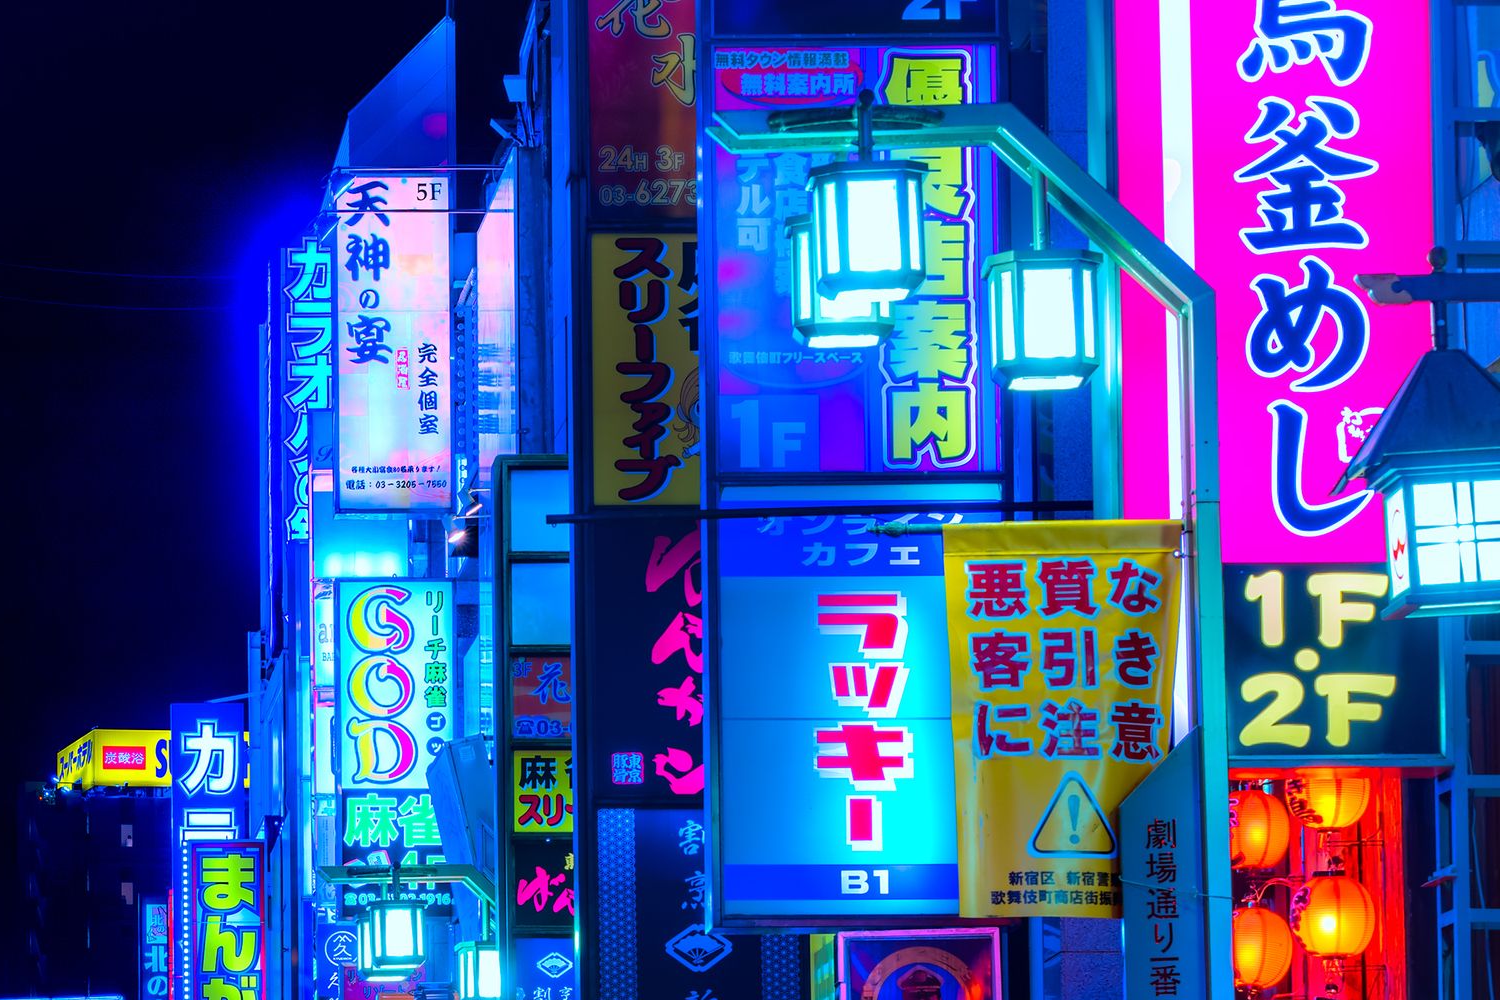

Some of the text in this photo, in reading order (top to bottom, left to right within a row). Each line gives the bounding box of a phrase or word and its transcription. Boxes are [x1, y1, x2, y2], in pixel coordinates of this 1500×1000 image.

[715, 51, 850, 69] 無料タウン情報満載
[740, 72, 857, 96] 無料案内所
[598, 146, 685, 172] 24H 3F
[416, 182, 443, 202] 5F
[344, 179, 394, 366] 天神の宴
[417, 342, 440, 436] 完全個室
[612, 235, 681, 501] スリーファイブ
[728, 351, 864, 364] 歌舞伎町フリースペース
[731, 401, 806, 469] 1F
[801, 543, 920, 567] カフェ
[964, 556, 1164, 620] 悪質な
[1244, 569, 1390, 649] 1F
[423, 591, 447, 708] リーチ麻雀
[968, 627, 1163, 691] 客引き
[345, 584, 418, 784] GOD
[1238, 672, 1397, 749] 2F
[814, 590, 914, 852] ラッキー
[973, 698, 1165, 763] に注意
[59, 738, 93, 781] スーパーホテル
[103, 750, 147, 766] 炭酸浴
[343, 793, 443, 849] 麻雀
[840, 869, 890, 895] B1
[1007, 870, 1056, 887] 新宿区
